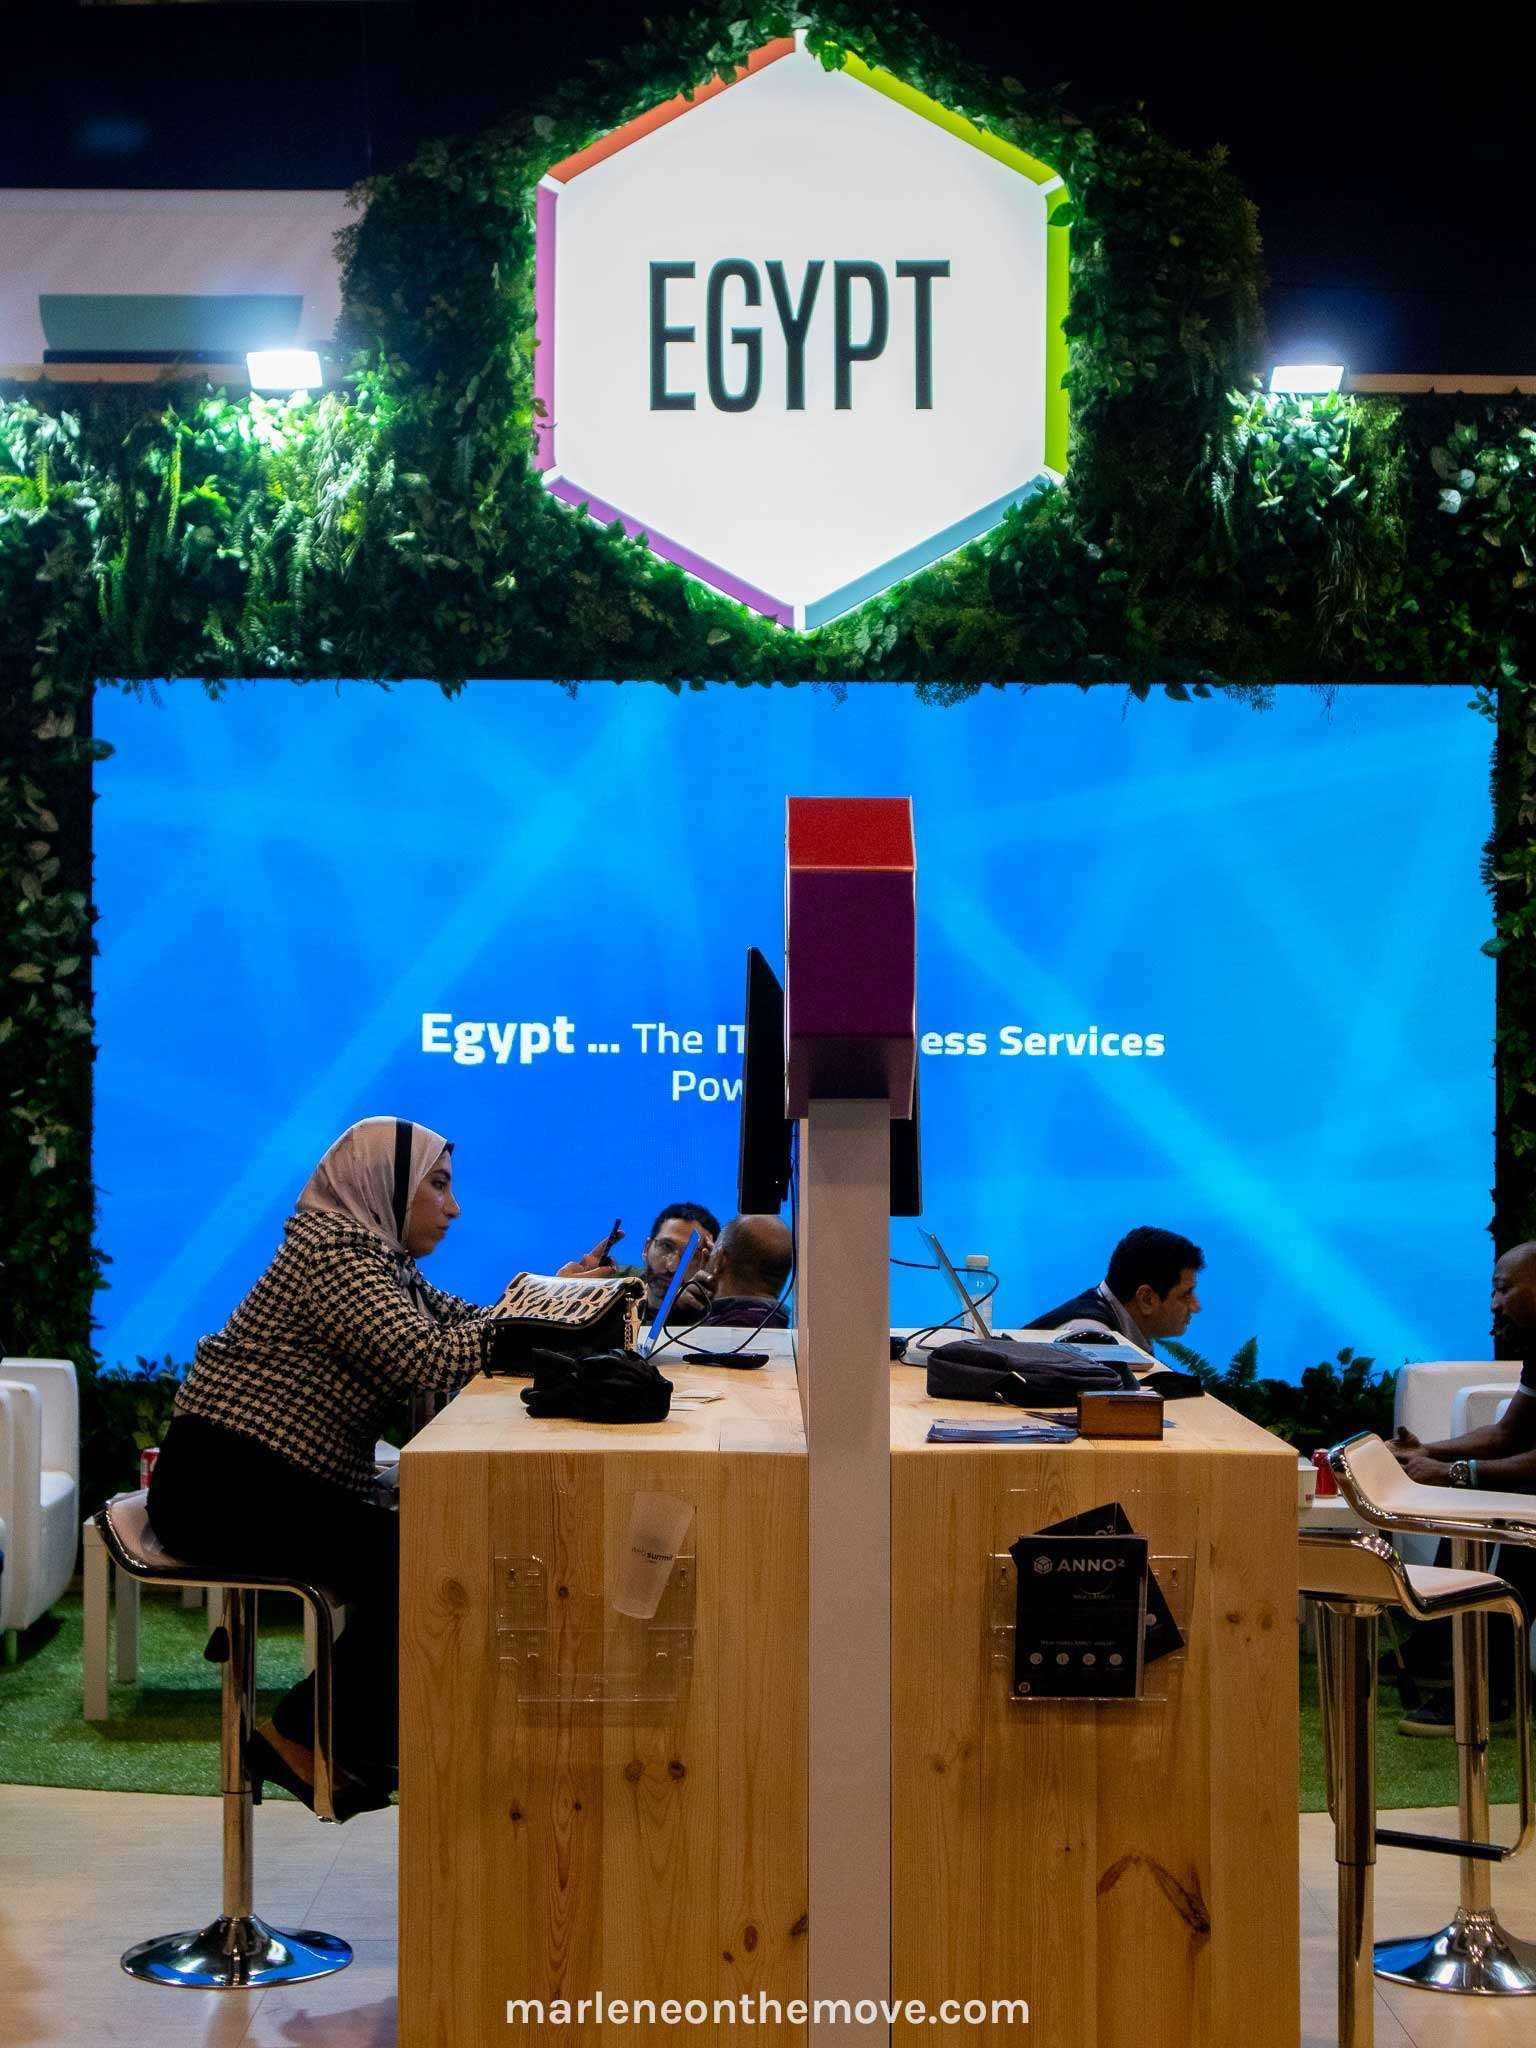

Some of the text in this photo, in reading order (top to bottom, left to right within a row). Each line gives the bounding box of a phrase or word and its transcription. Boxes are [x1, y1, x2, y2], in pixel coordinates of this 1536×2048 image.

[649, 258, 951, 413] EGYPT
[421, 1013, 575, 1066] Egypt
[631, 1022, 703, 1054] The
[999, 1025, 1165, 1057] Services
